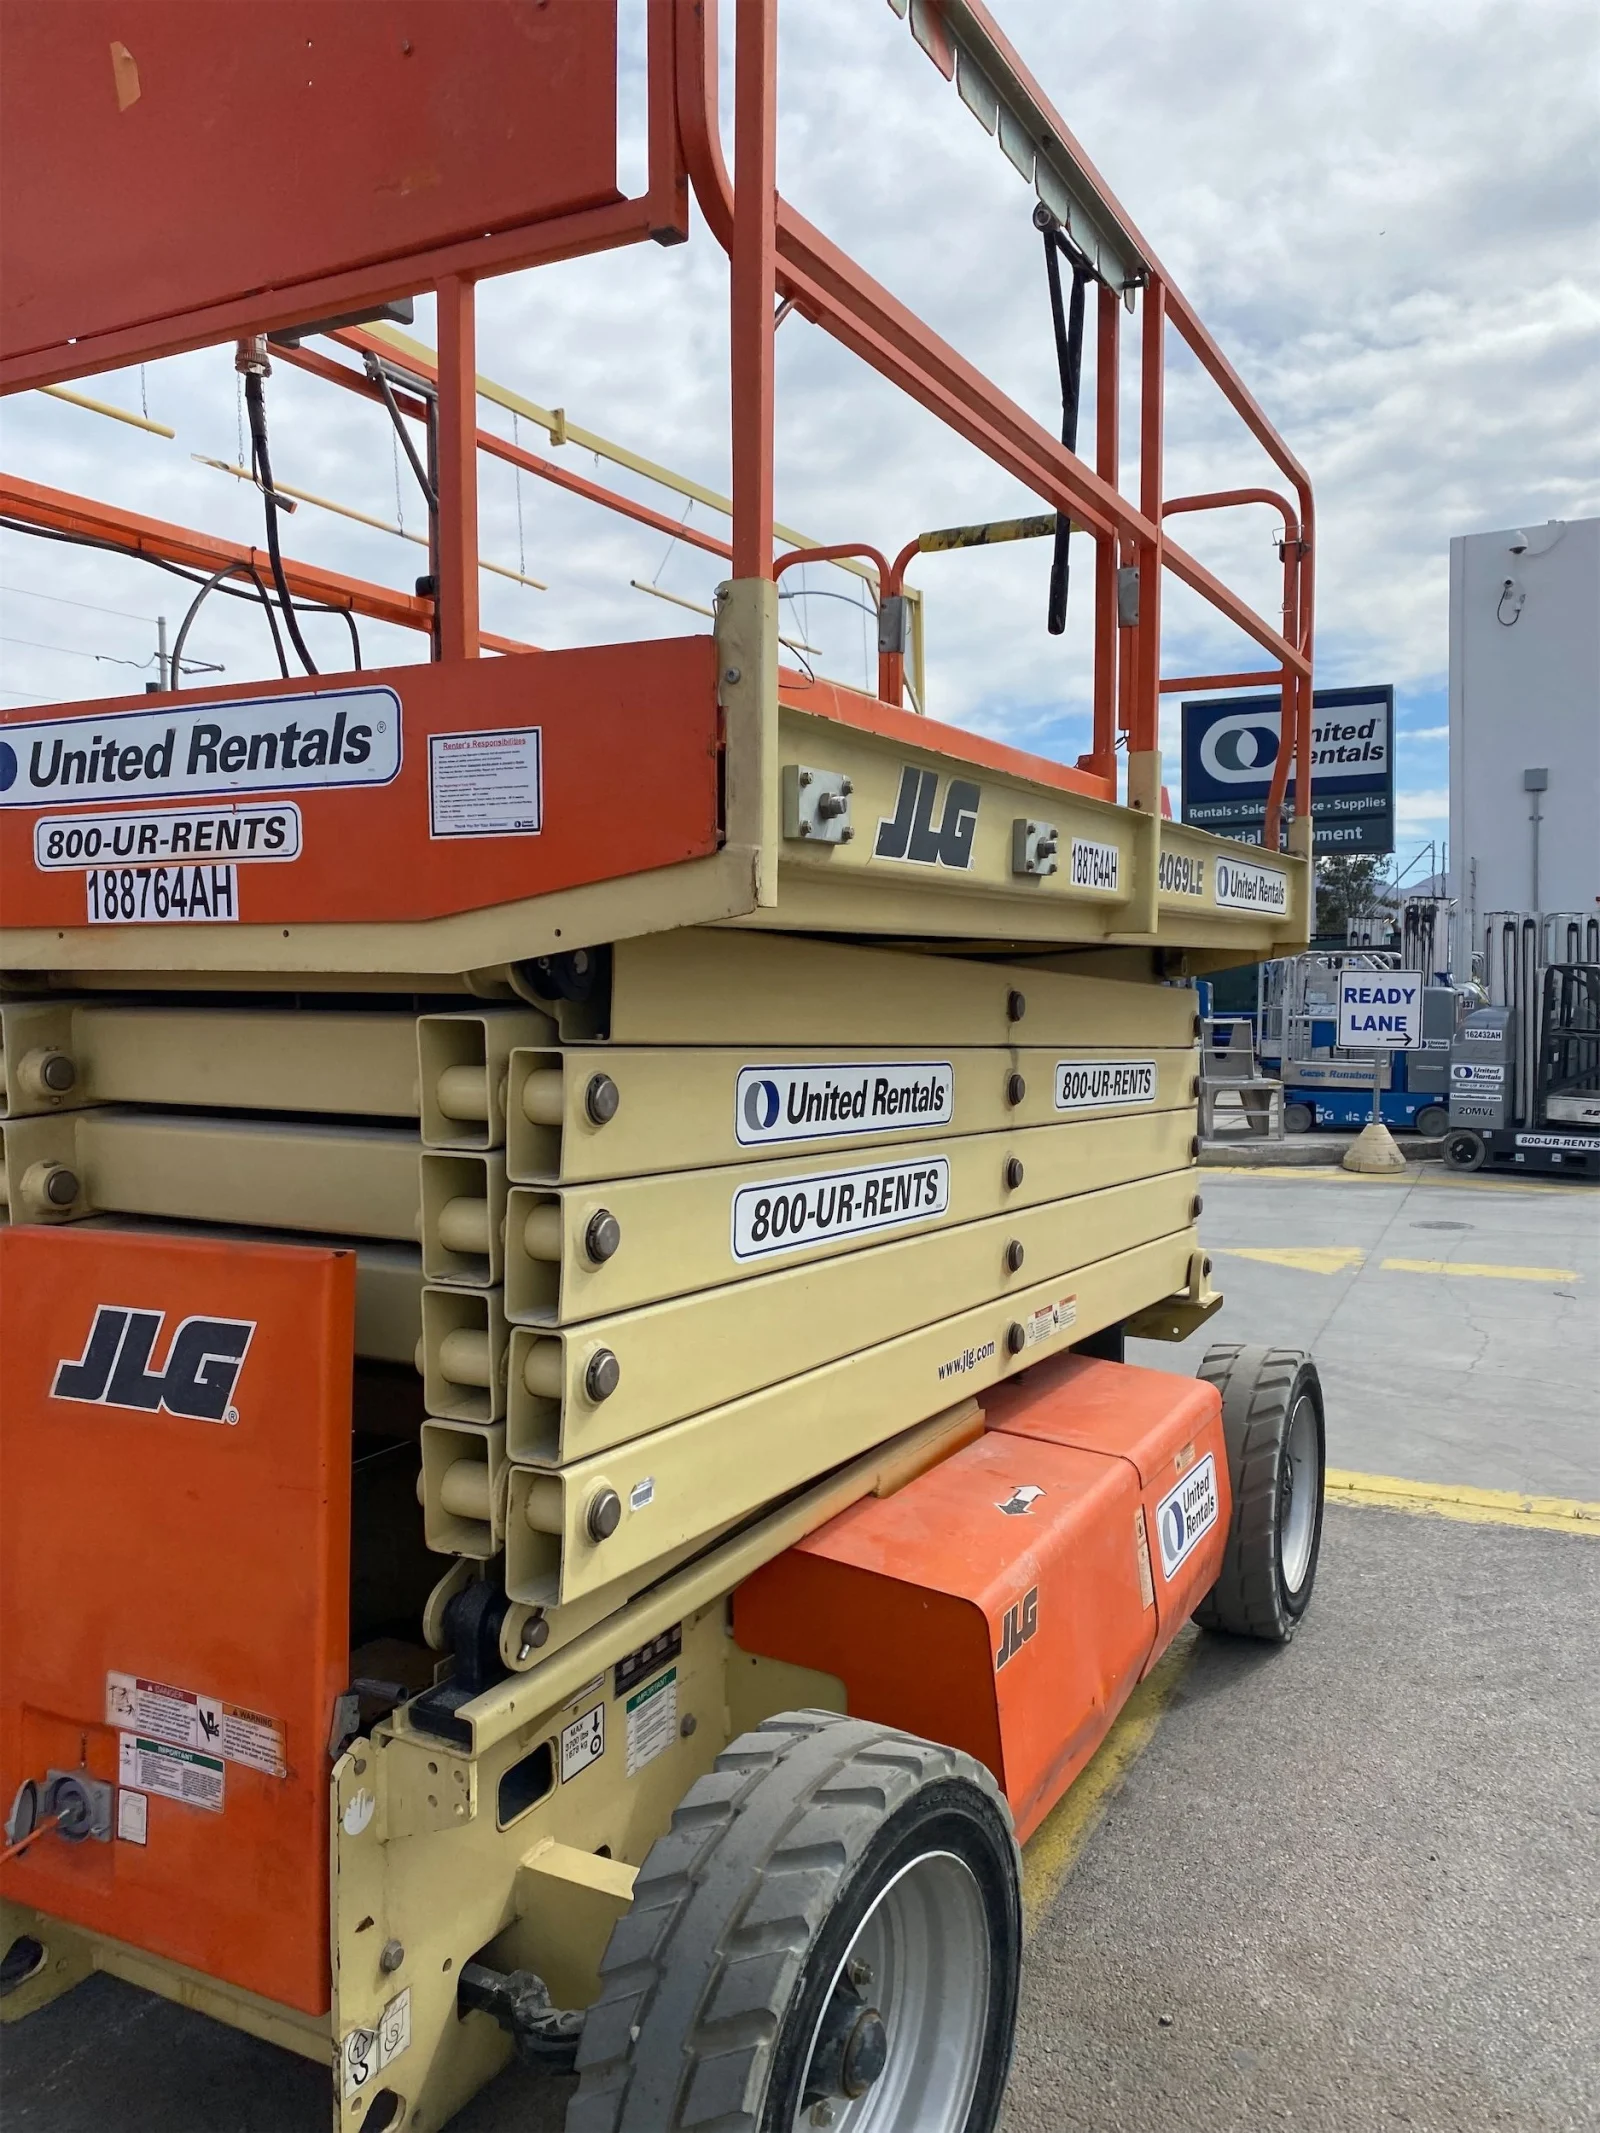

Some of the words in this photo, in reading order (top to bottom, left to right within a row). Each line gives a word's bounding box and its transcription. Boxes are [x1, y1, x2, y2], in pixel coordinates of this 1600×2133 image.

[442, 741, 471, 751] Renter's
[472, 738, 527, 749] Responsibilities
[1311, 718, 1377, 743] nited
[29, 727, 177, 788] United
[187, 711, 373, 777] Rentals
[1310, 741, 1385, 765] entals
[875, 765, 982, 872] JLG
[1189, 805, 1232, 819] Rentals
[1241, 803, 1268, 815] Sale
[1334, 797, 1387, 811] Supplies
[46, 815, 288, 860] 800-UR-RENTS
[1071, 843, 1118, 889] 188764AH
[88, 864, 233, 920] 188764AH
[1230, 868, 1258, 901] United
[1258, 873, 1285, 905] Rentals
[1344, 987, 1416, 1005] READY
[1350, 1015, 1407, 1032] LANE
[1465, 1030, 1501, 1040] 162432AH
[1062, 1067, 1152, 1101] 800-UR-RENTS
[1473, 1066, 1500, 1074] United
[1473, 1073, 1502, 1081] Rentals
[786, 1078, 869, 1126] United
[872, 1076, 945, 1118] Rentals
[1458, 1106, 1495, 1116] 20MVL
[1521, 1136, 1600, 1148] 800-UR-RENTS
[751, 1169, 938, 1243] 800-UR-RENTS
[51, 1304, 257, 1424] JLG
[938, 1341, 995, 1381] www.jlg.com
[1183, 1469, 1211, 1514] United
[1186, 1495, 1215, 1540] Rentals
[996, 1585, 1038, 1673] JLG
[154, 1685, 184, 1699] DANGER
[636, 1675, 668, 1704] IMPORTANT
[240, 1711, 273, 1728] WARNING
[157, 1745, 193, 1762] IMPORTANT
